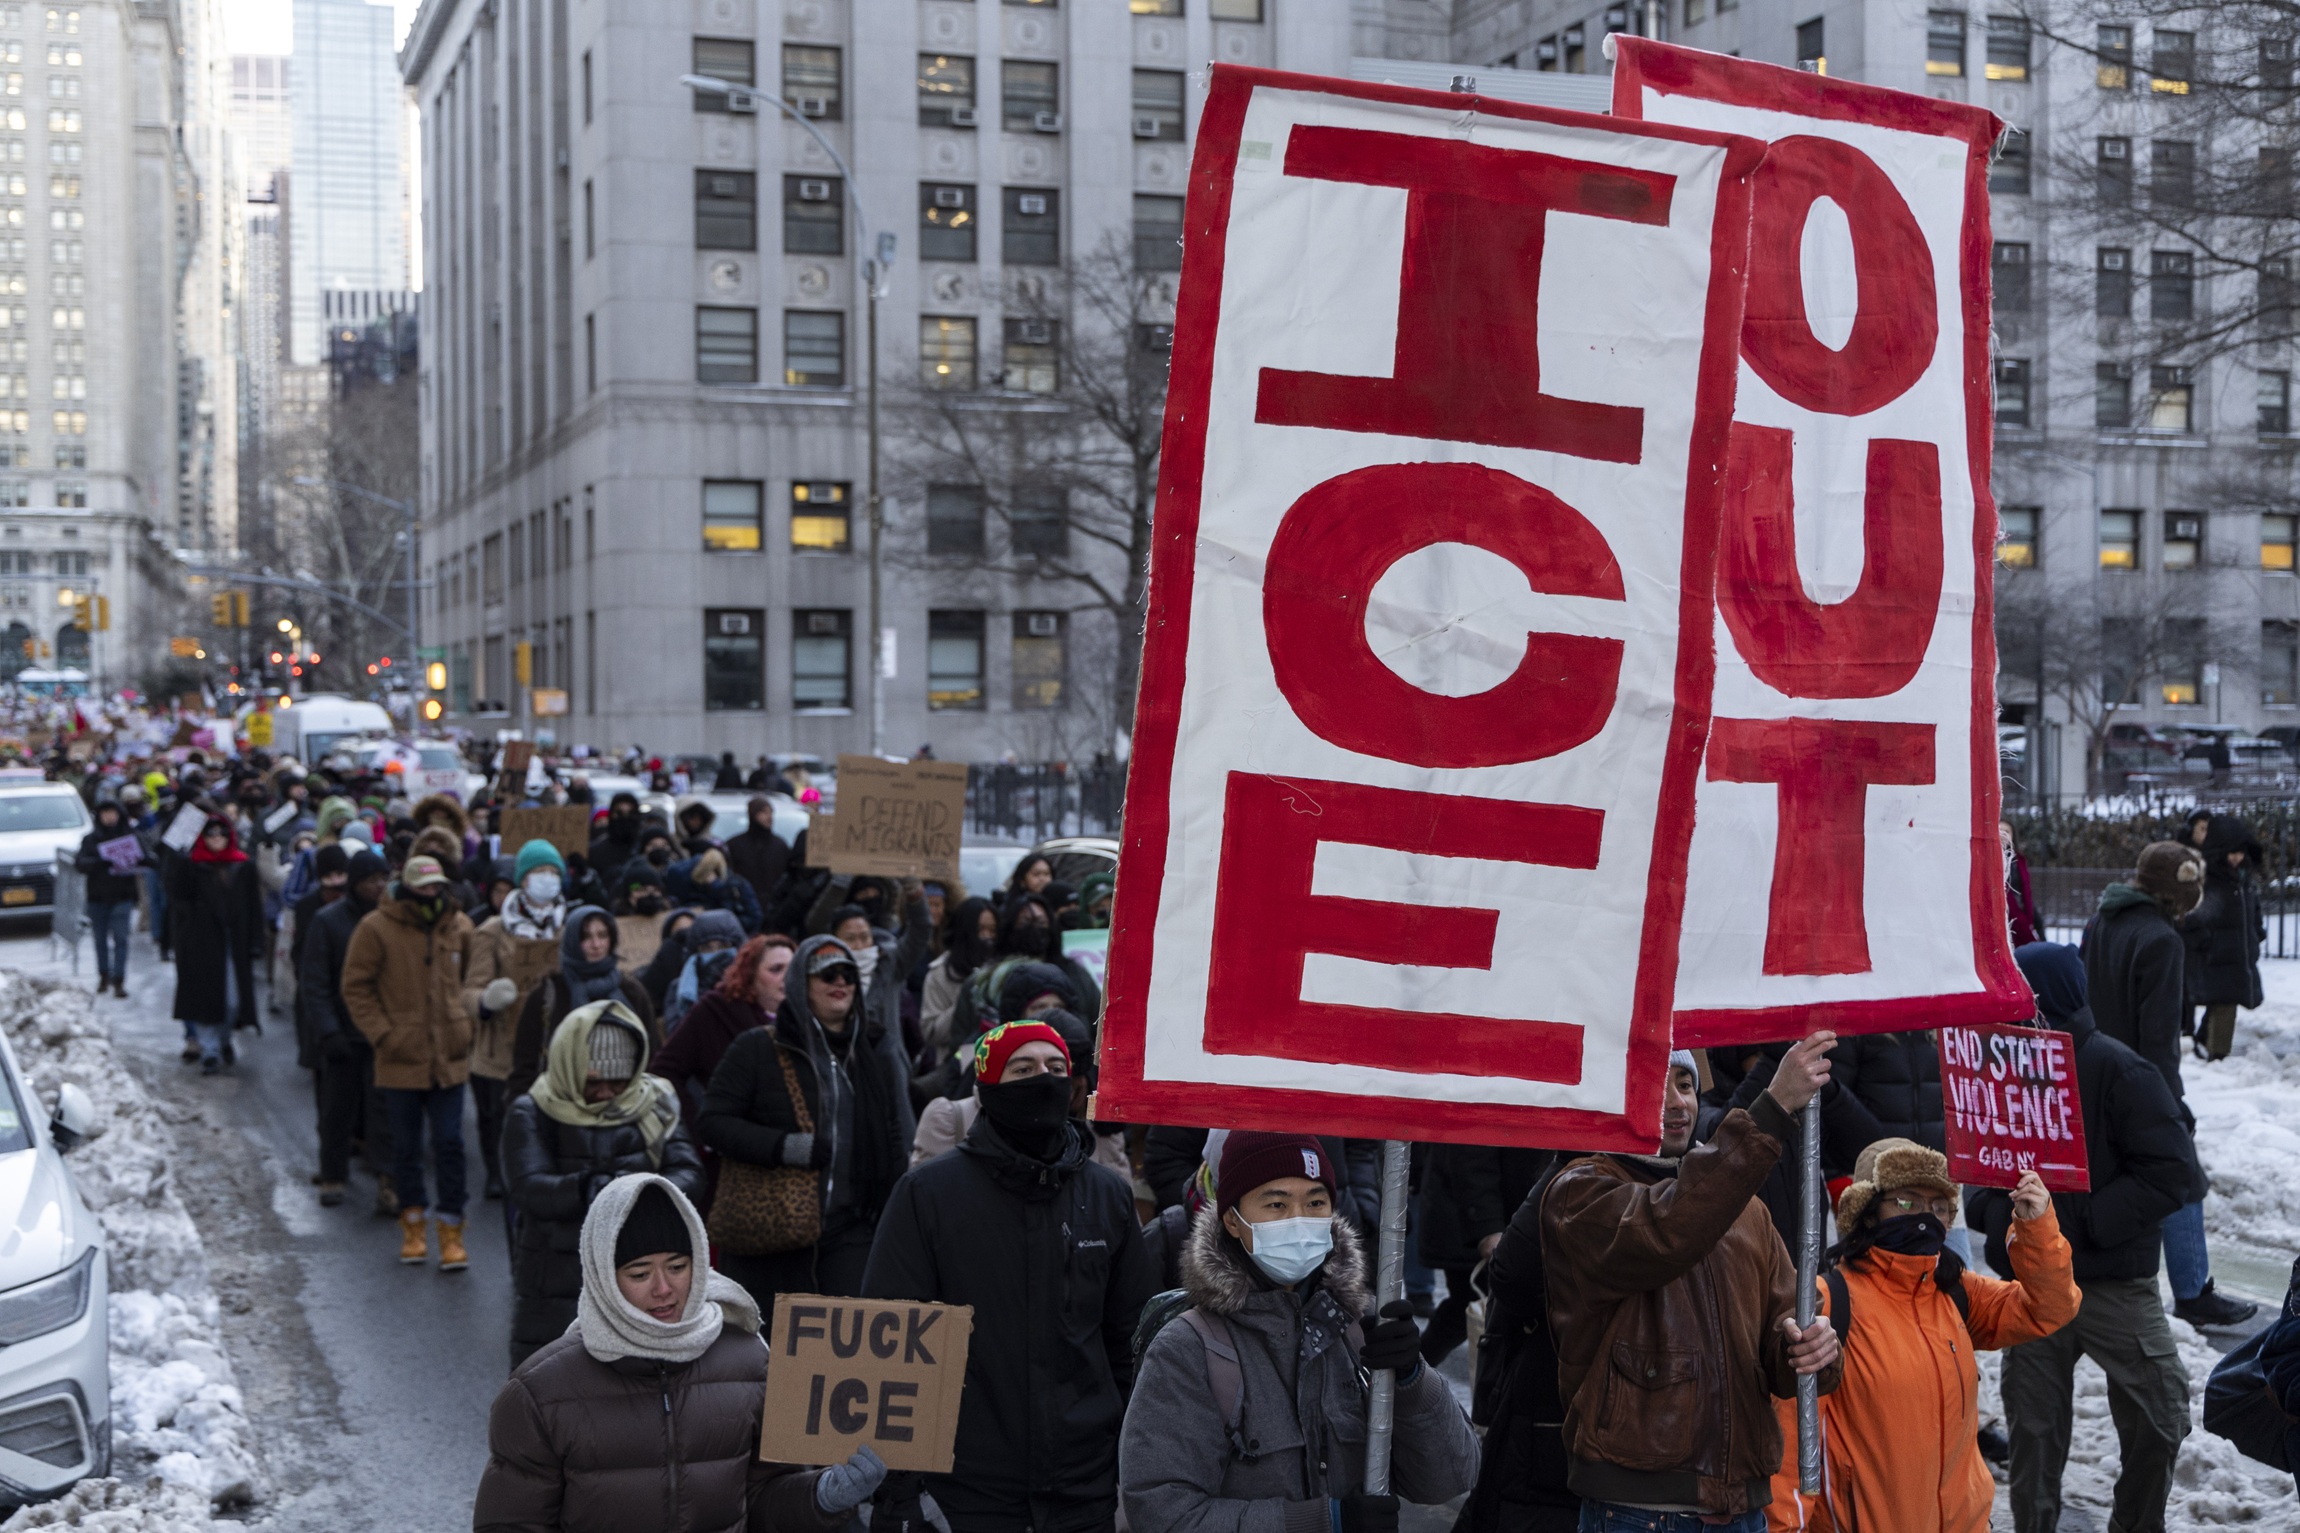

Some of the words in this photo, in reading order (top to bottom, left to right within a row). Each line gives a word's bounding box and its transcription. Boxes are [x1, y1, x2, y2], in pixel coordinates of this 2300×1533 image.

[1704, 134, 1944, 976] OUT
[1203, 123, 1678, 1085] ICE
[844, 822, 956, 857] MIGRANTS
[860, 795, 949, 832] DEFEND
[1943, 1027, 1983, 1072] END
[1989, 1033, 2067, 1081] STATE
[1948, 1073, 2074, 1141] VIOLENCE
[1979, 1146, 2015, 1171] GAB
[2016, 1151, 2036, 1171] NY
[786, 1305, 944, 1365] FUCK
[805, 1374, 919, 1443] ICE
